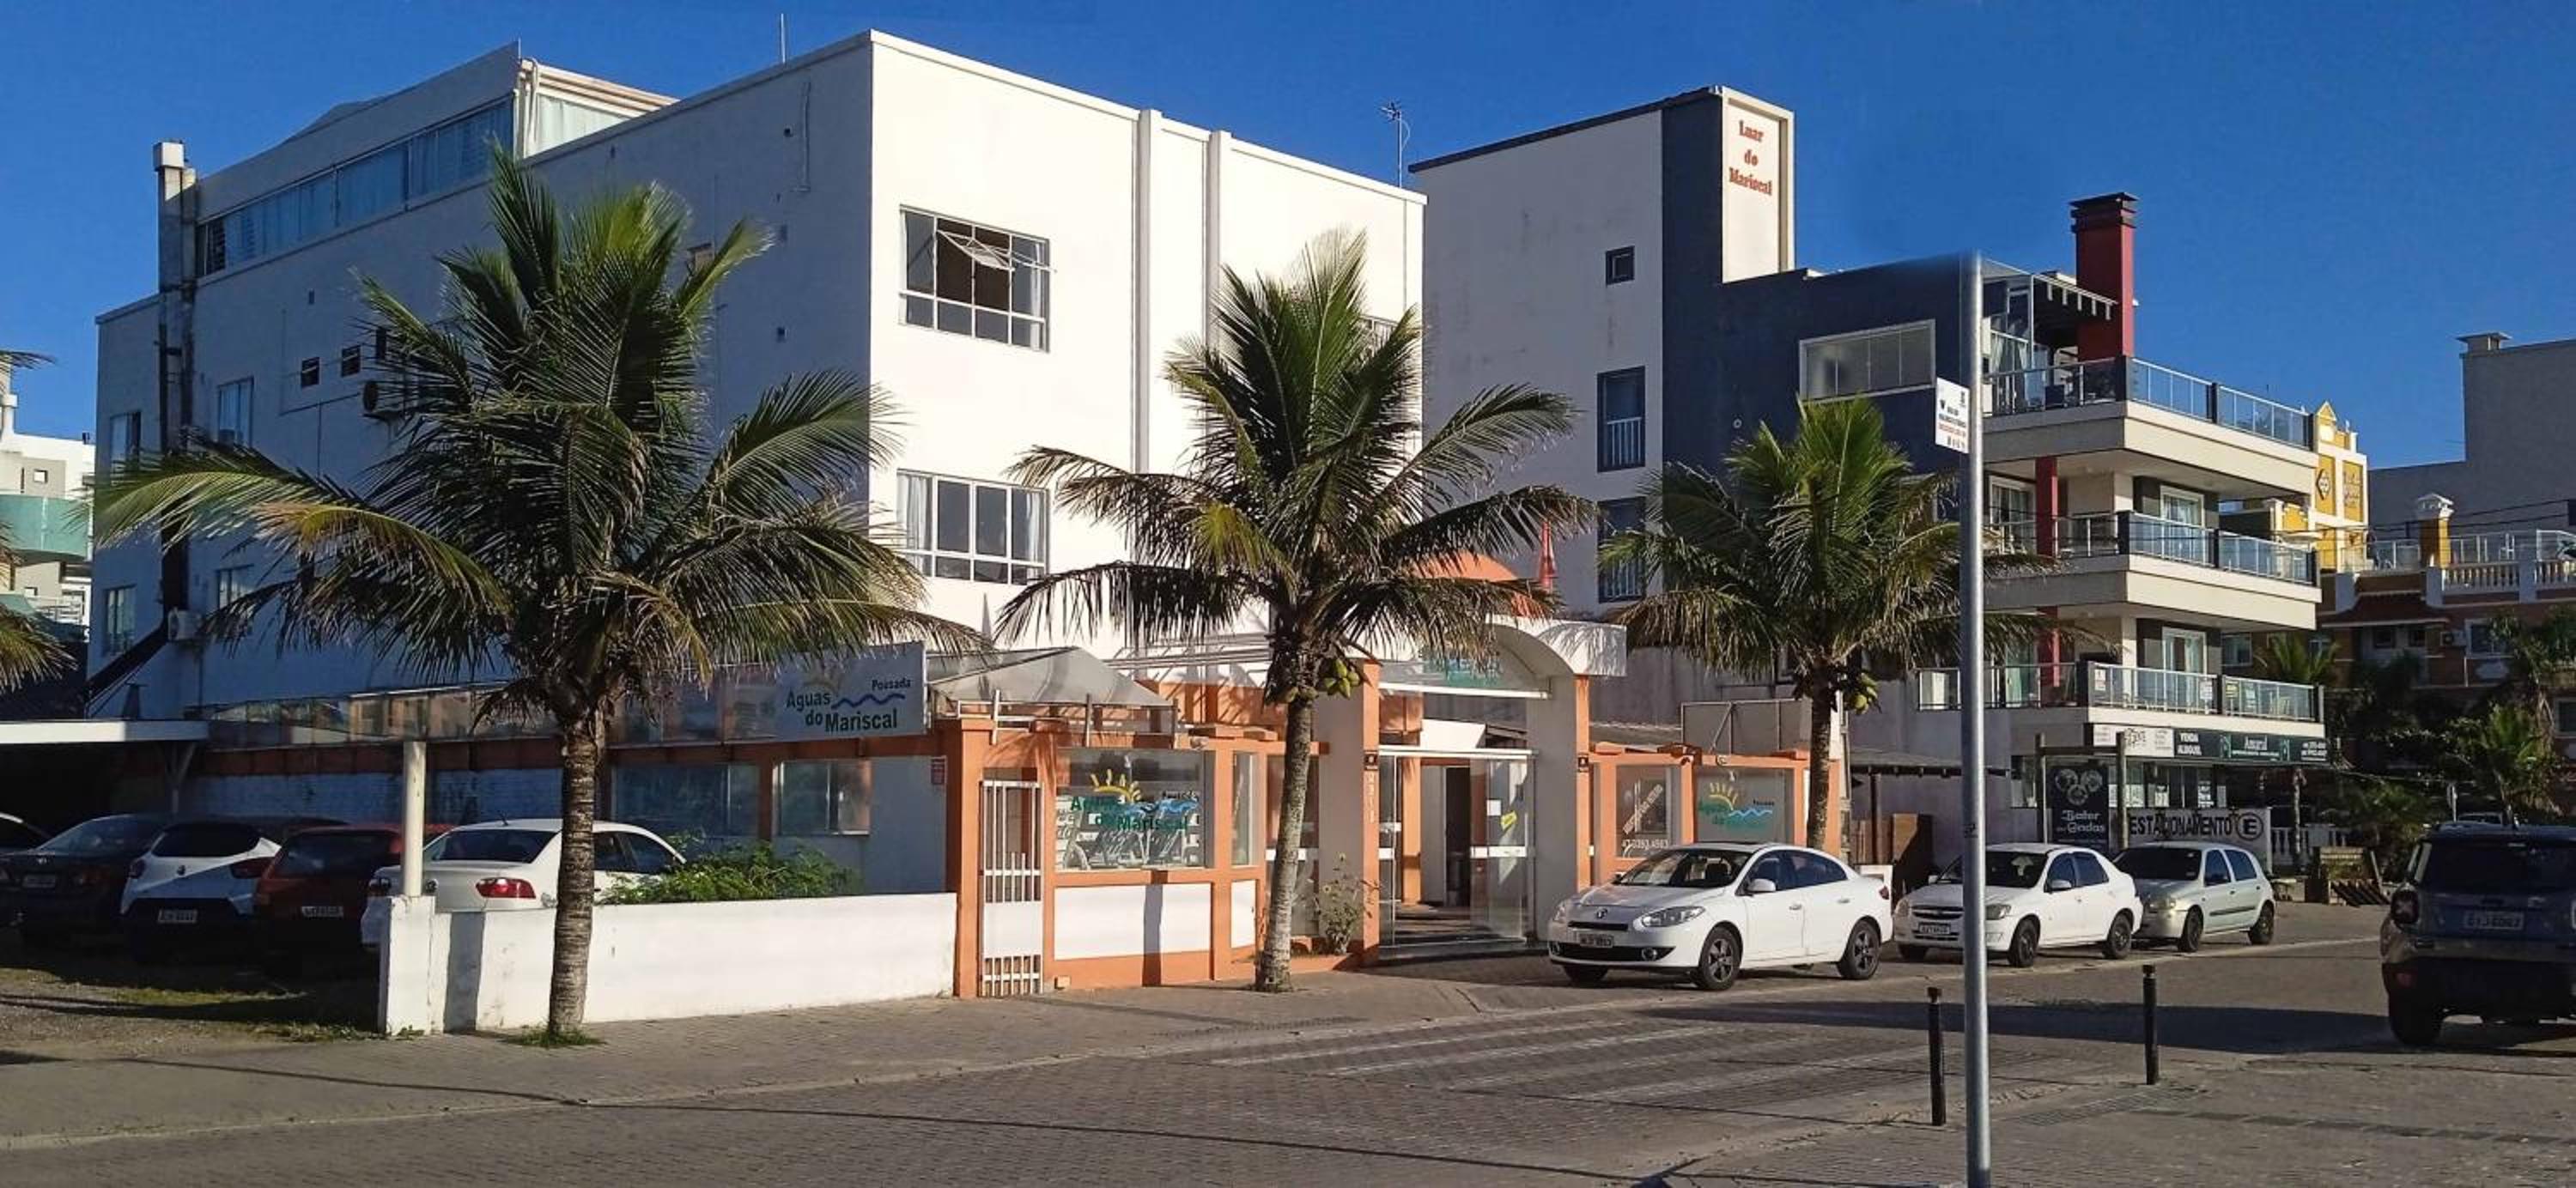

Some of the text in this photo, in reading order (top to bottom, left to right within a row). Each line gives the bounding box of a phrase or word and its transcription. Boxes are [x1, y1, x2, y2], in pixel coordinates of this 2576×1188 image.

[1739, 120, 1764, 142] Luar
[1744, 149, 1759, 166] do
[1729, 167, 1772, 196] Mariscal
[872, 677, 911, 691] Pousada
[805, 709, 823, 726] do
[825, 707, 898, 732] Mariscal
